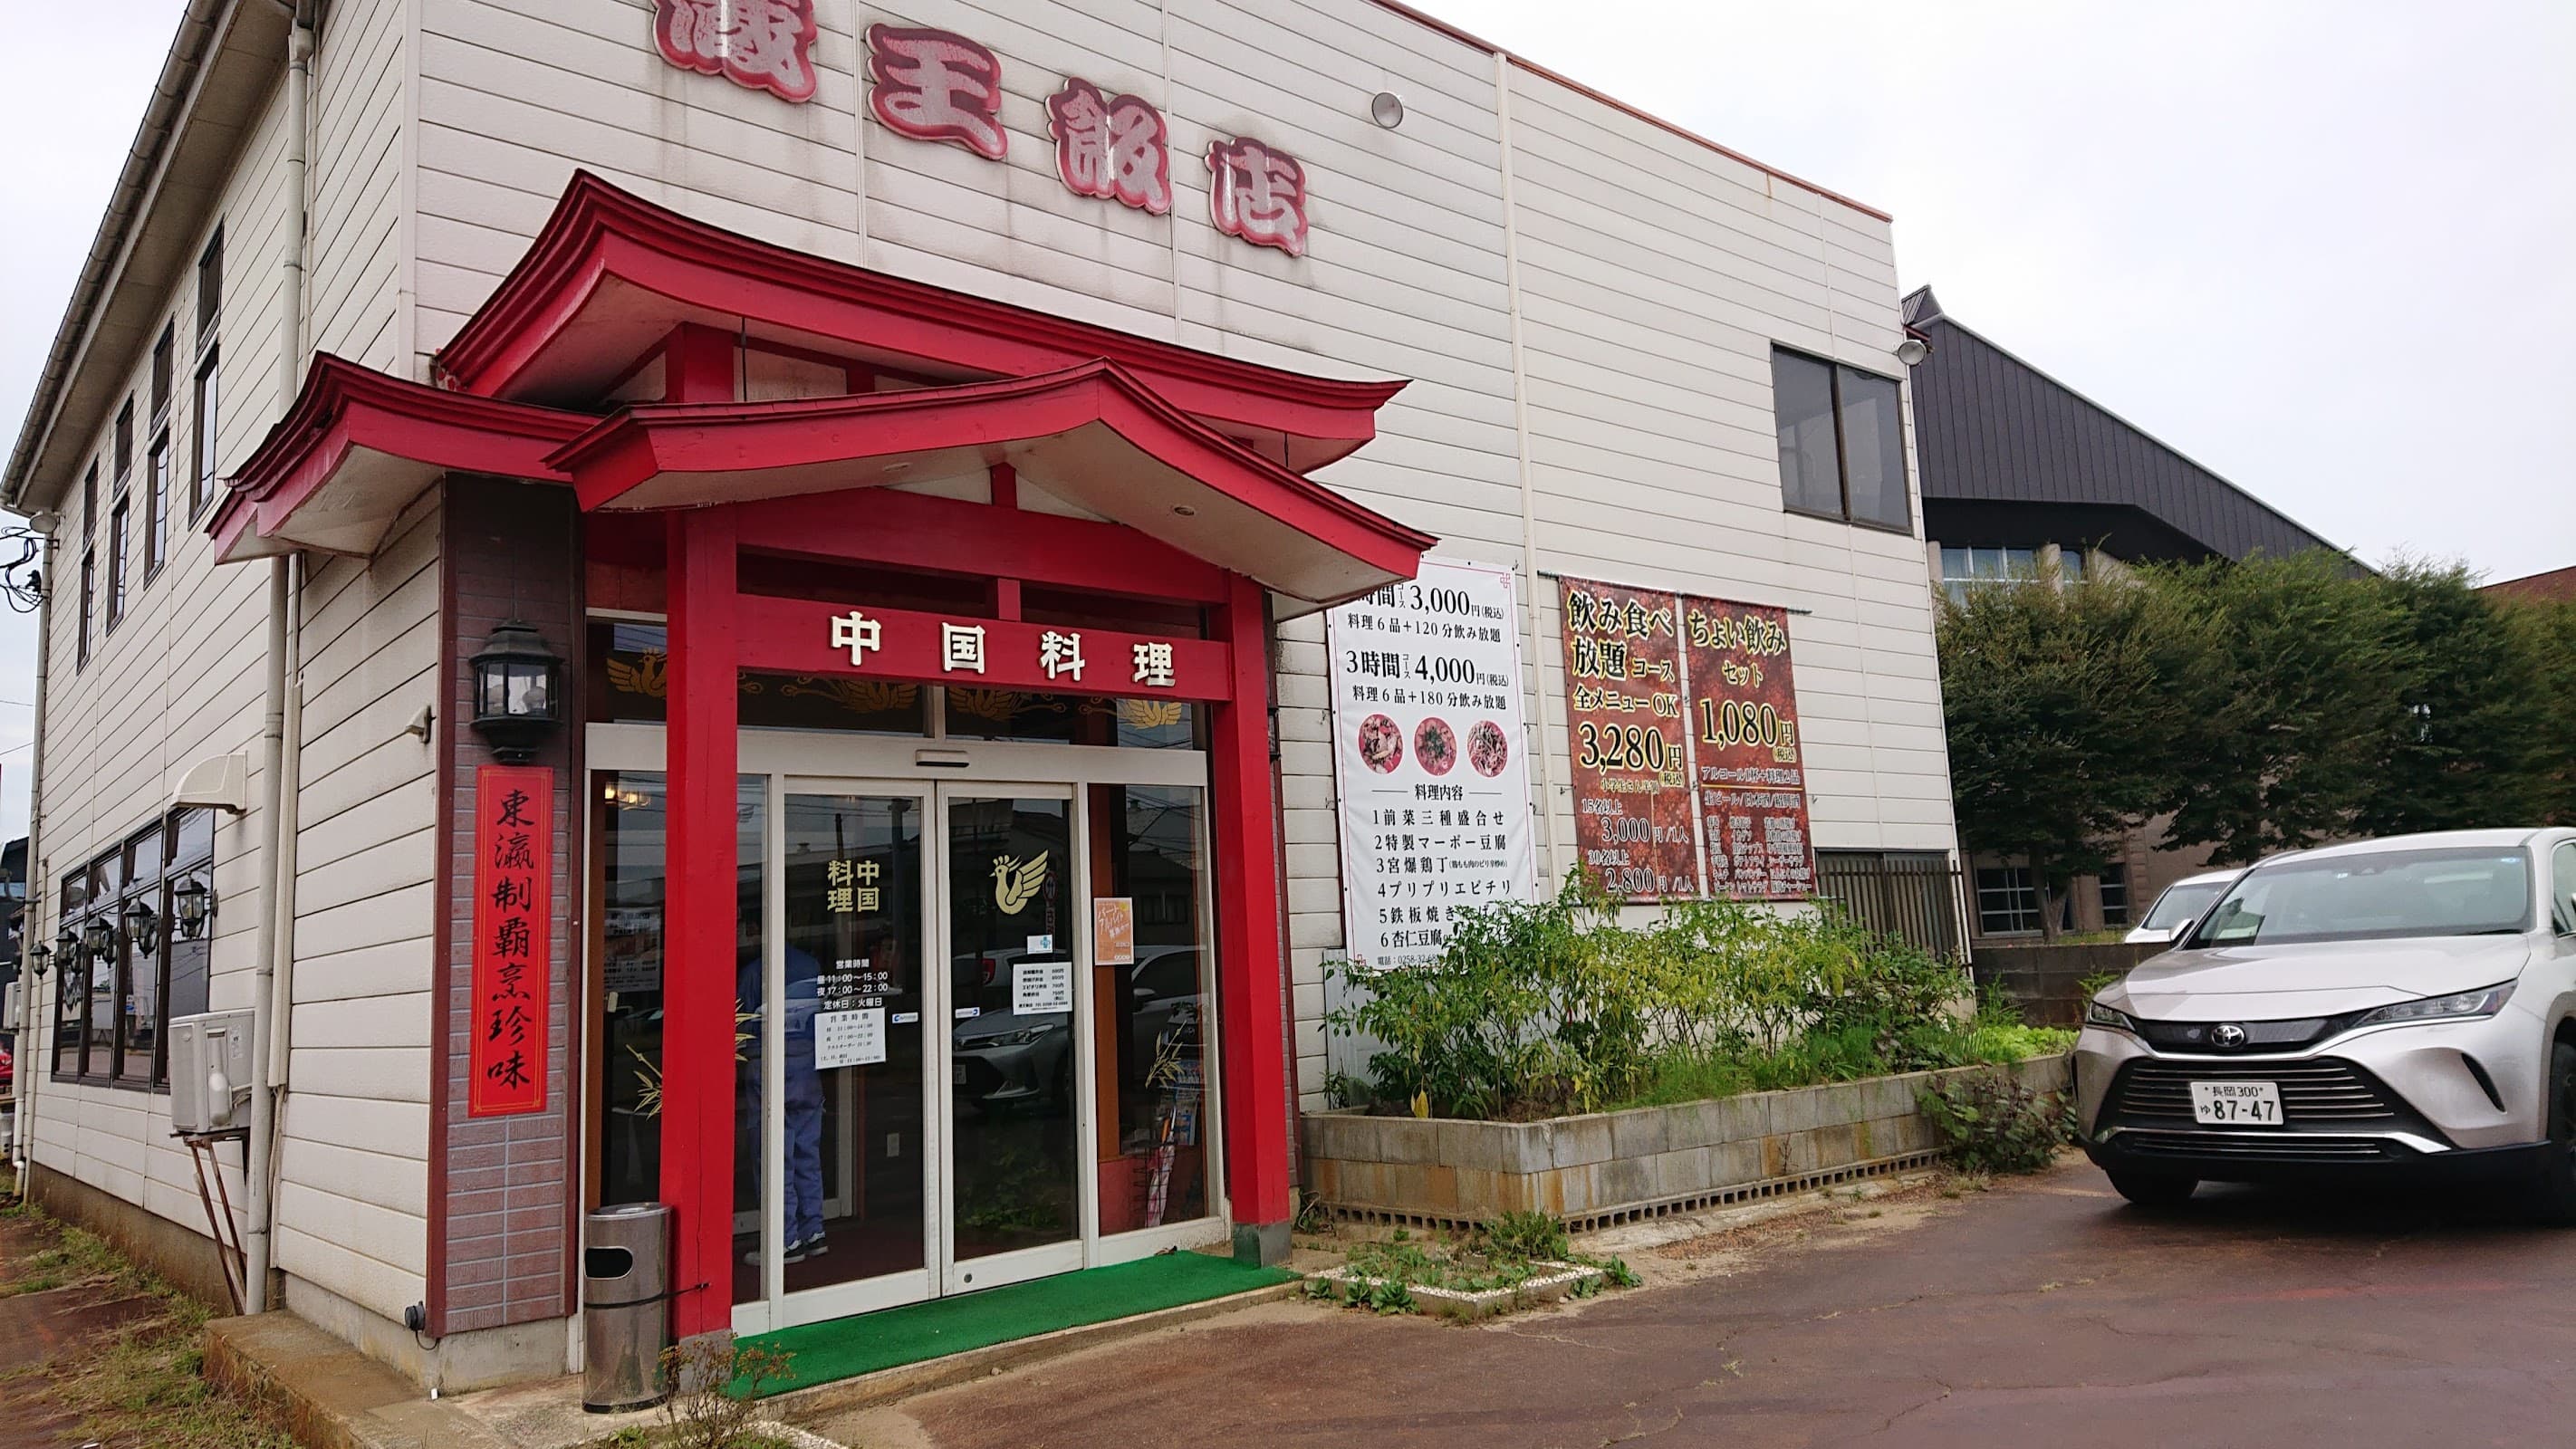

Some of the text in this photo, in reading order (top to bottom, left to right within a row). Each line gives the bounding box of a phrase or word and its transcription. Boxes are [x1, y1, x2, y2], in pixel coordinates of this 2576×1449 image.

[1567, 591, 1675, 639] 飲み食べ
[1687, 608, 1787, 656] ちょい飲み
[831, 610, 1176, 687] 中国料理
[1572, 637, 1675, 683] 放題 コース
[1346, 650, 1400, 679] 3時間
[1723, 660, 1764, 688] セット
[1572, 685, 1679, 718] 全メニューOK
[1699, 697, 1795, 751] 1,080円
[1577, 721, 1684, 775] 3,280円
[1415, 783, 1464, 801] 料理内容
[1581, 798, 1623, 815] 15名以上
[1601, 817, 1663, 845] 3,000円
[1588, 849, 1630, 867] 30名以上
[1605, 868, 1668, 896] 2,800円
[1380, 930, 1442, 948] 6杏仁豆腐
[836, 958, 870, 970] 営業時間
[2213, 1099, 2275, 1121] 87-47
